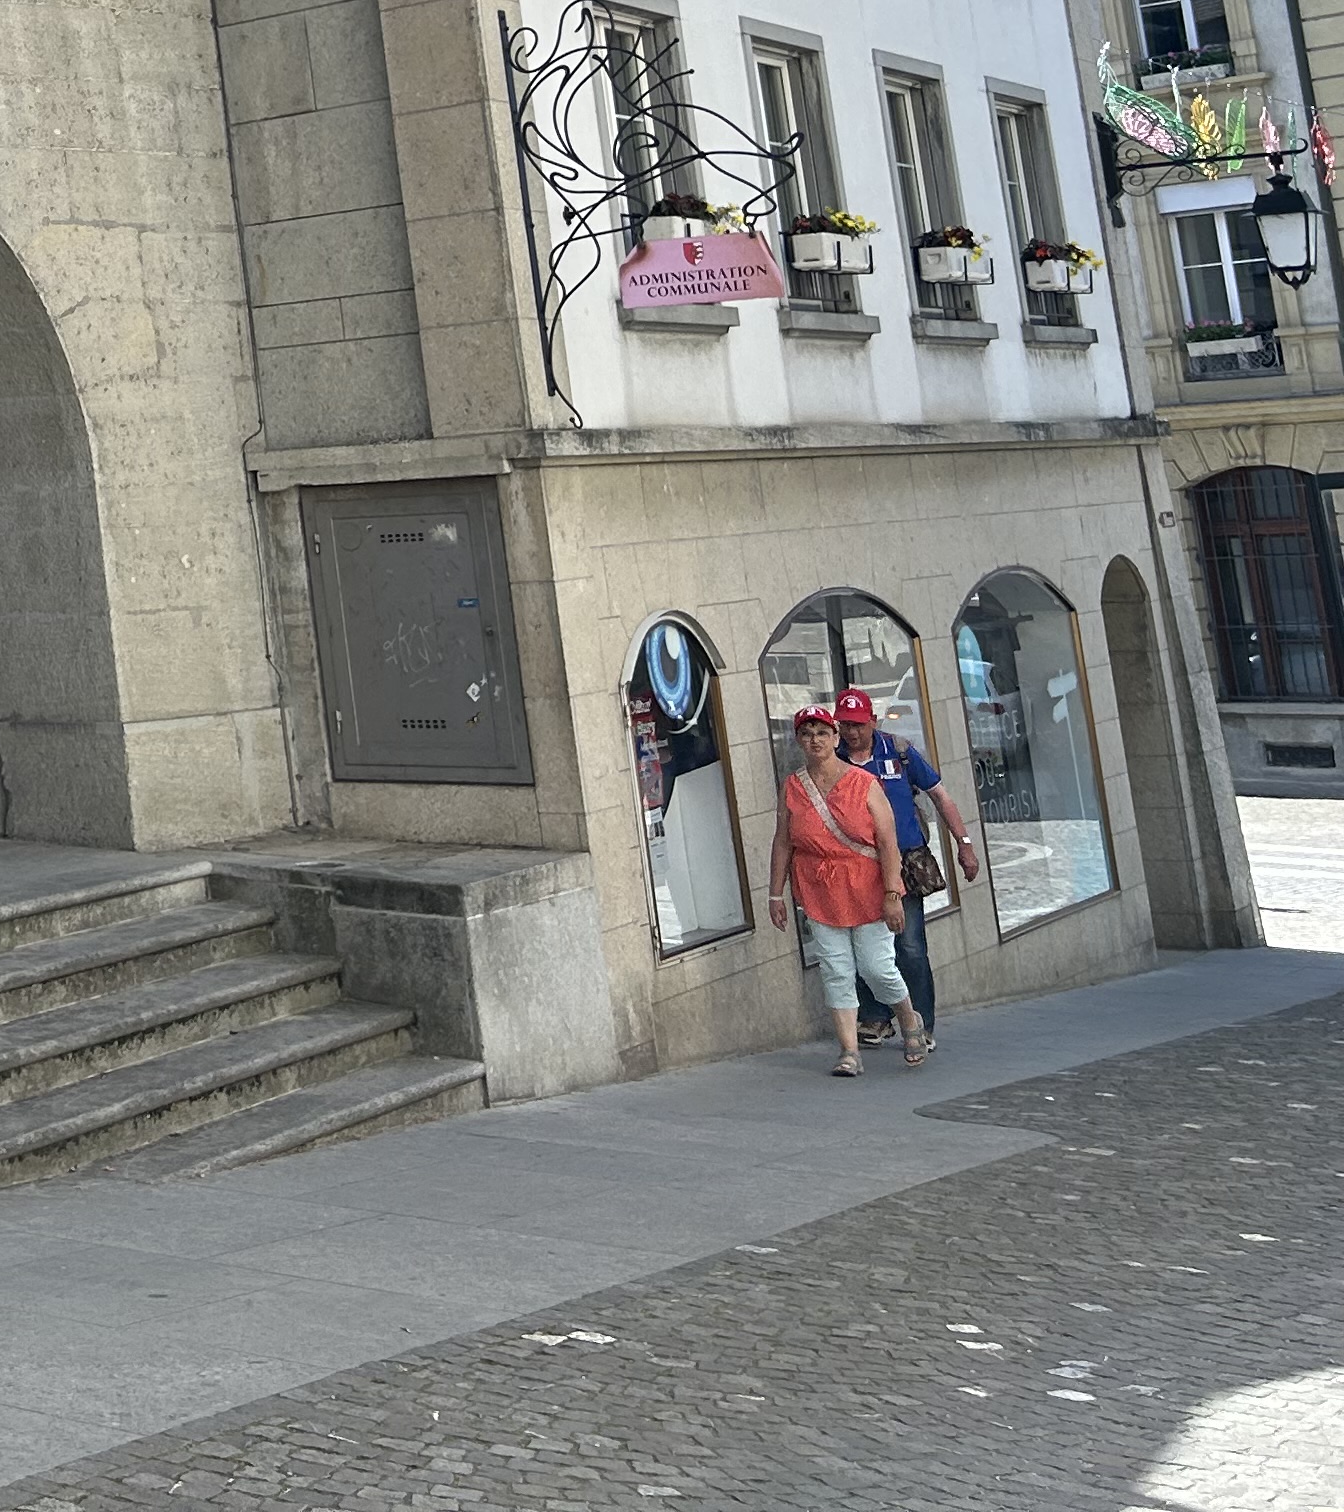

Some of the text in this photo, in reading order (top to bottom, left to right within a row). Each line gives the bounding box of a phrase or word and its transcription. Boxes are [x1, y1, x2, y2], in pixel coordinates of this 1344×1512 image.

[629, 264, 768, 288] ADMINISTRATION
[647, 279, 750, 299] COMMUNALE
[846, 698, 857, 709] 3
